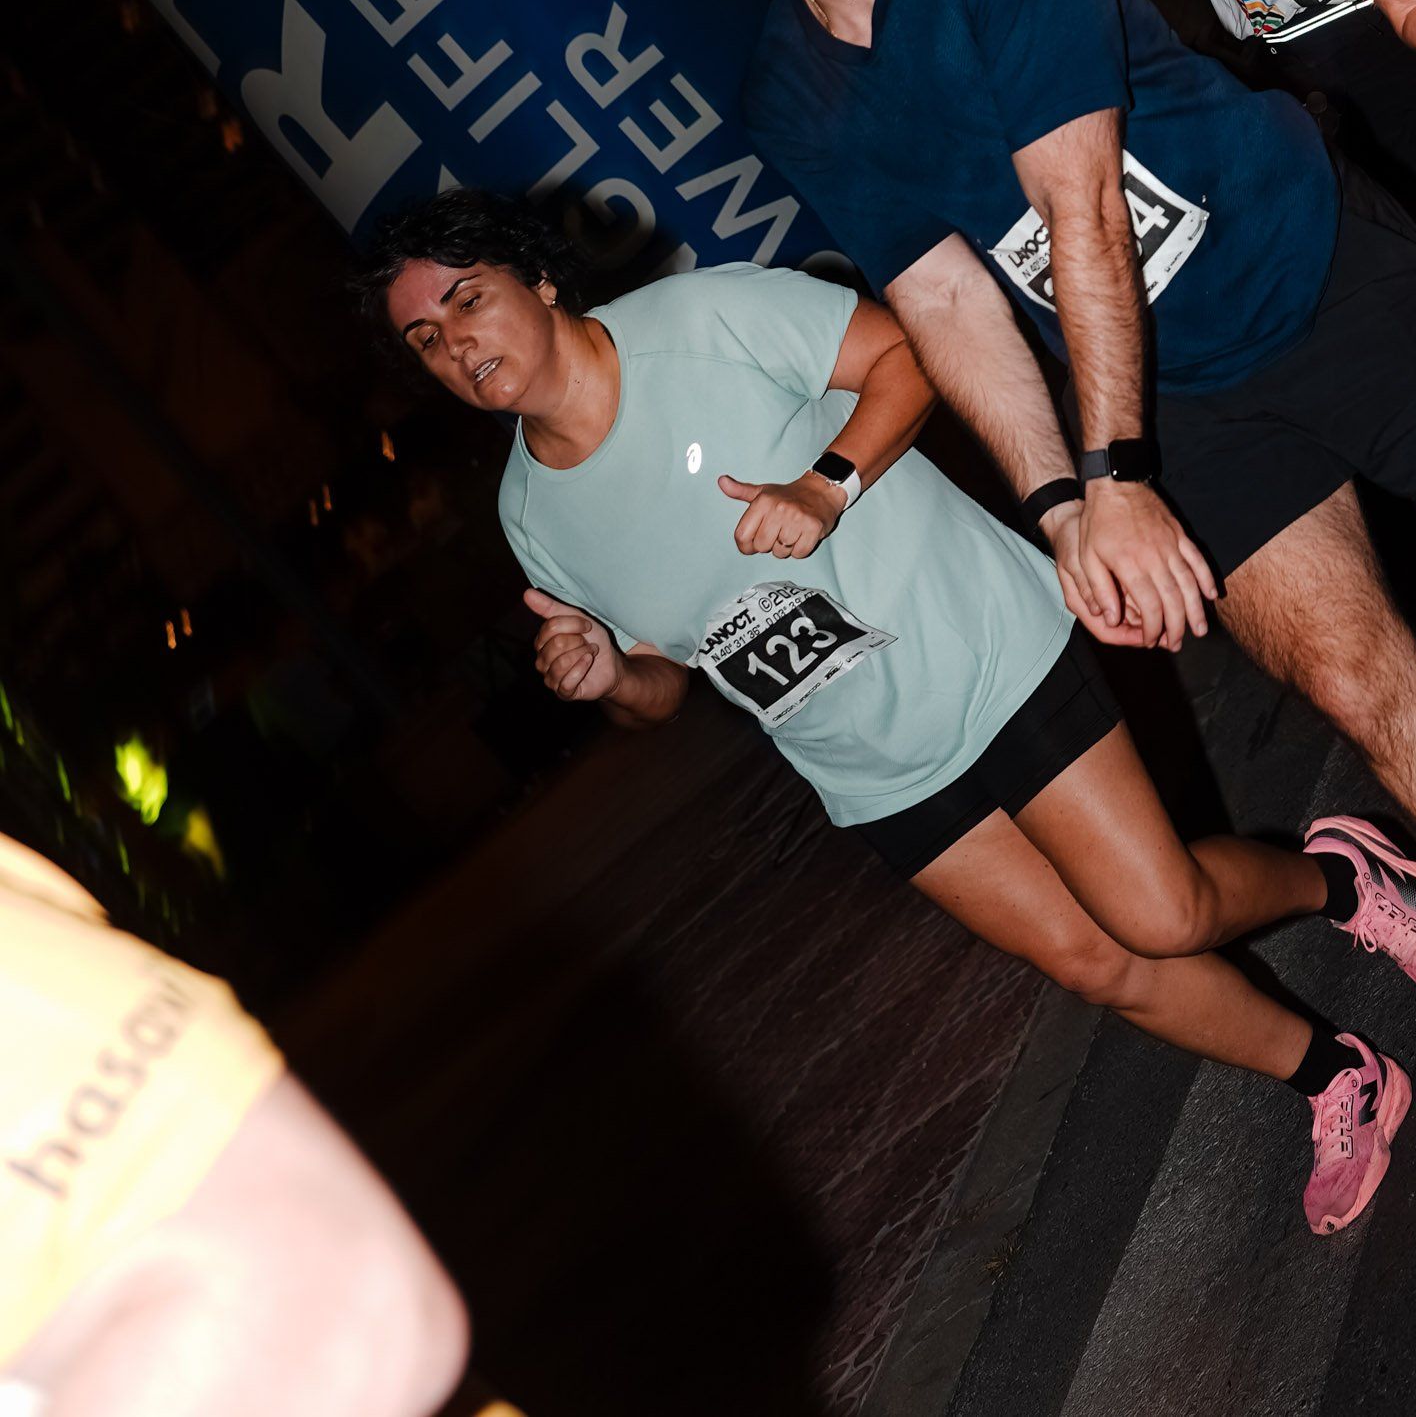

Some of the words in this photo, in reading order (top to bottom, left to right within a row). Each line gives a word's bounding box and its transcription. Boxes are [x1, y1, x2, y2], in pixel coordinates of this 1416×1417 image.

[565, 1, 856, 281] WER
[734, 634, 748, 647] 31'
[747, 616, 838, 687] 123
